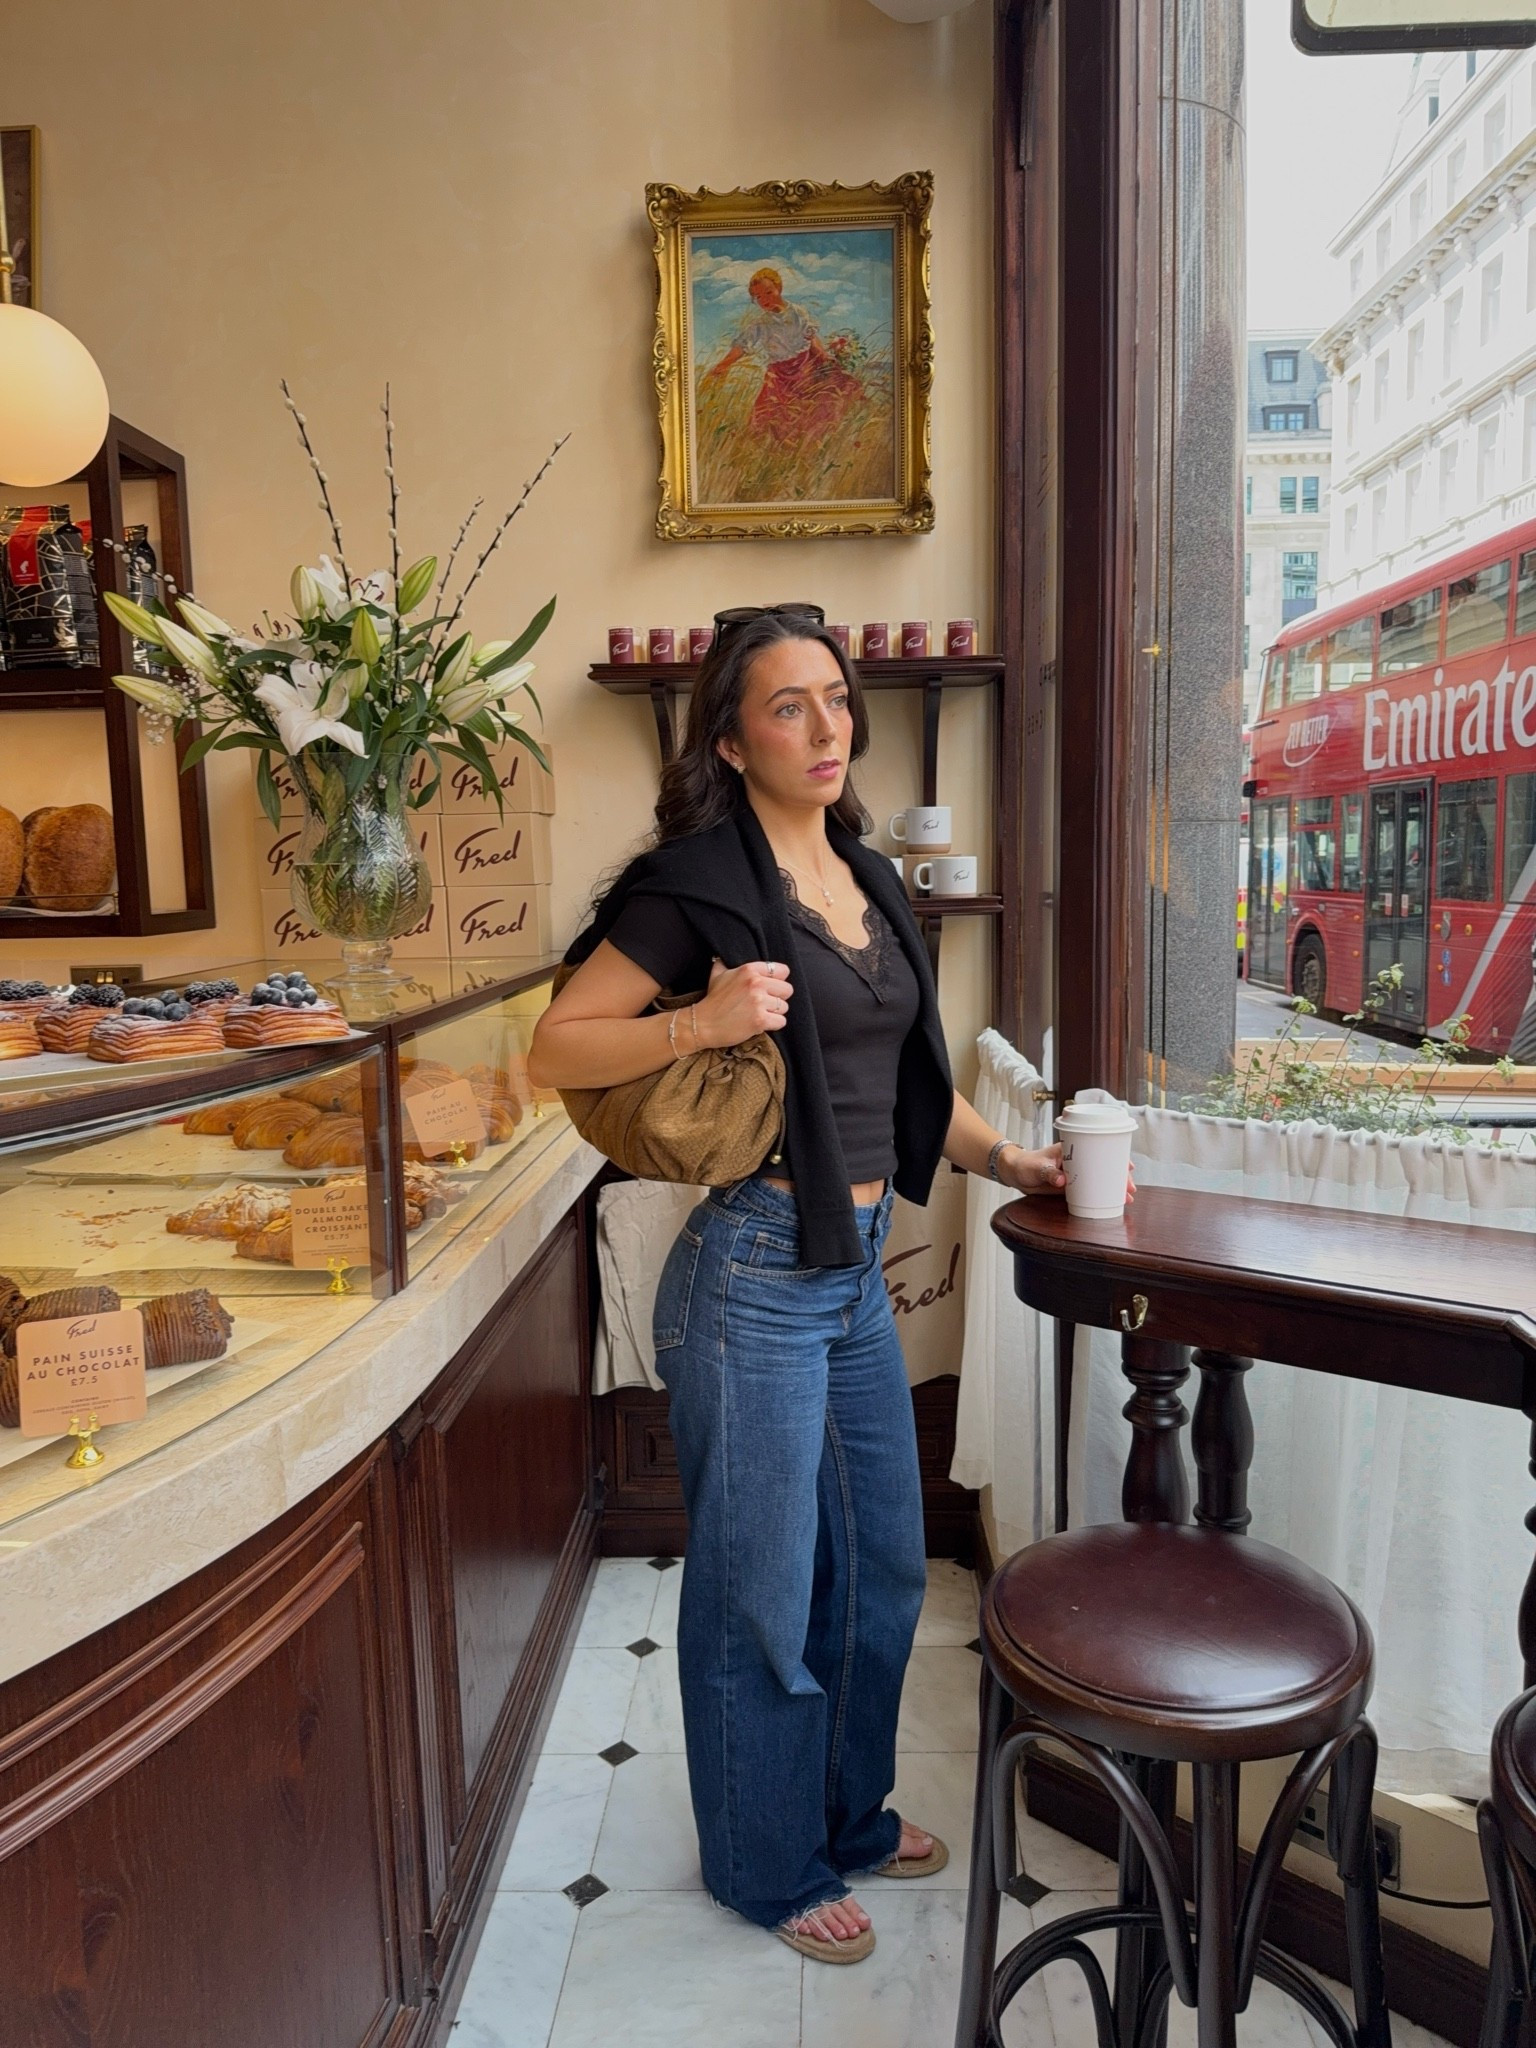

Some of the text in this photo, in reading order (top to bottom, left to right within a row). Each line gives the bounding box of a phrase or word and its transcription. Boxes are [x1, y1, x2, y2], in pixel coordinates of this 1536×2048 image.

[866, 637, 884, 652] Fred
[905, 636, 924, 650] Fred
[951, 635, 970, 649] Fred
[612, 643, 630, 656] Fred
[652, 643, 670, 656] Fred
[1300, 714, 1329, 748] BETTER
[451, 754, 519, 801] Frd
[922, 819, 940, 832] Fred
[454, 827, 521, 874] Fred
[953, 869, 970, 882] Fred
[460, 899, 527, 945] Fred
[324, 1188, 346, 1203] Fred
[295, 1206, 337, 1215] DOUBLE
[312, 1214, 360, 1223] ALMOND
[305, 1223, 368, 1233] CROISSANT
[66, 1319, 97, 1339] Fred
[33, 1344, 133, 1366] PAIN SUISSE
[27, 1356, 140, 1381] AU CHOCOLAT
[71, 1375, 98, 1387] £7.5
